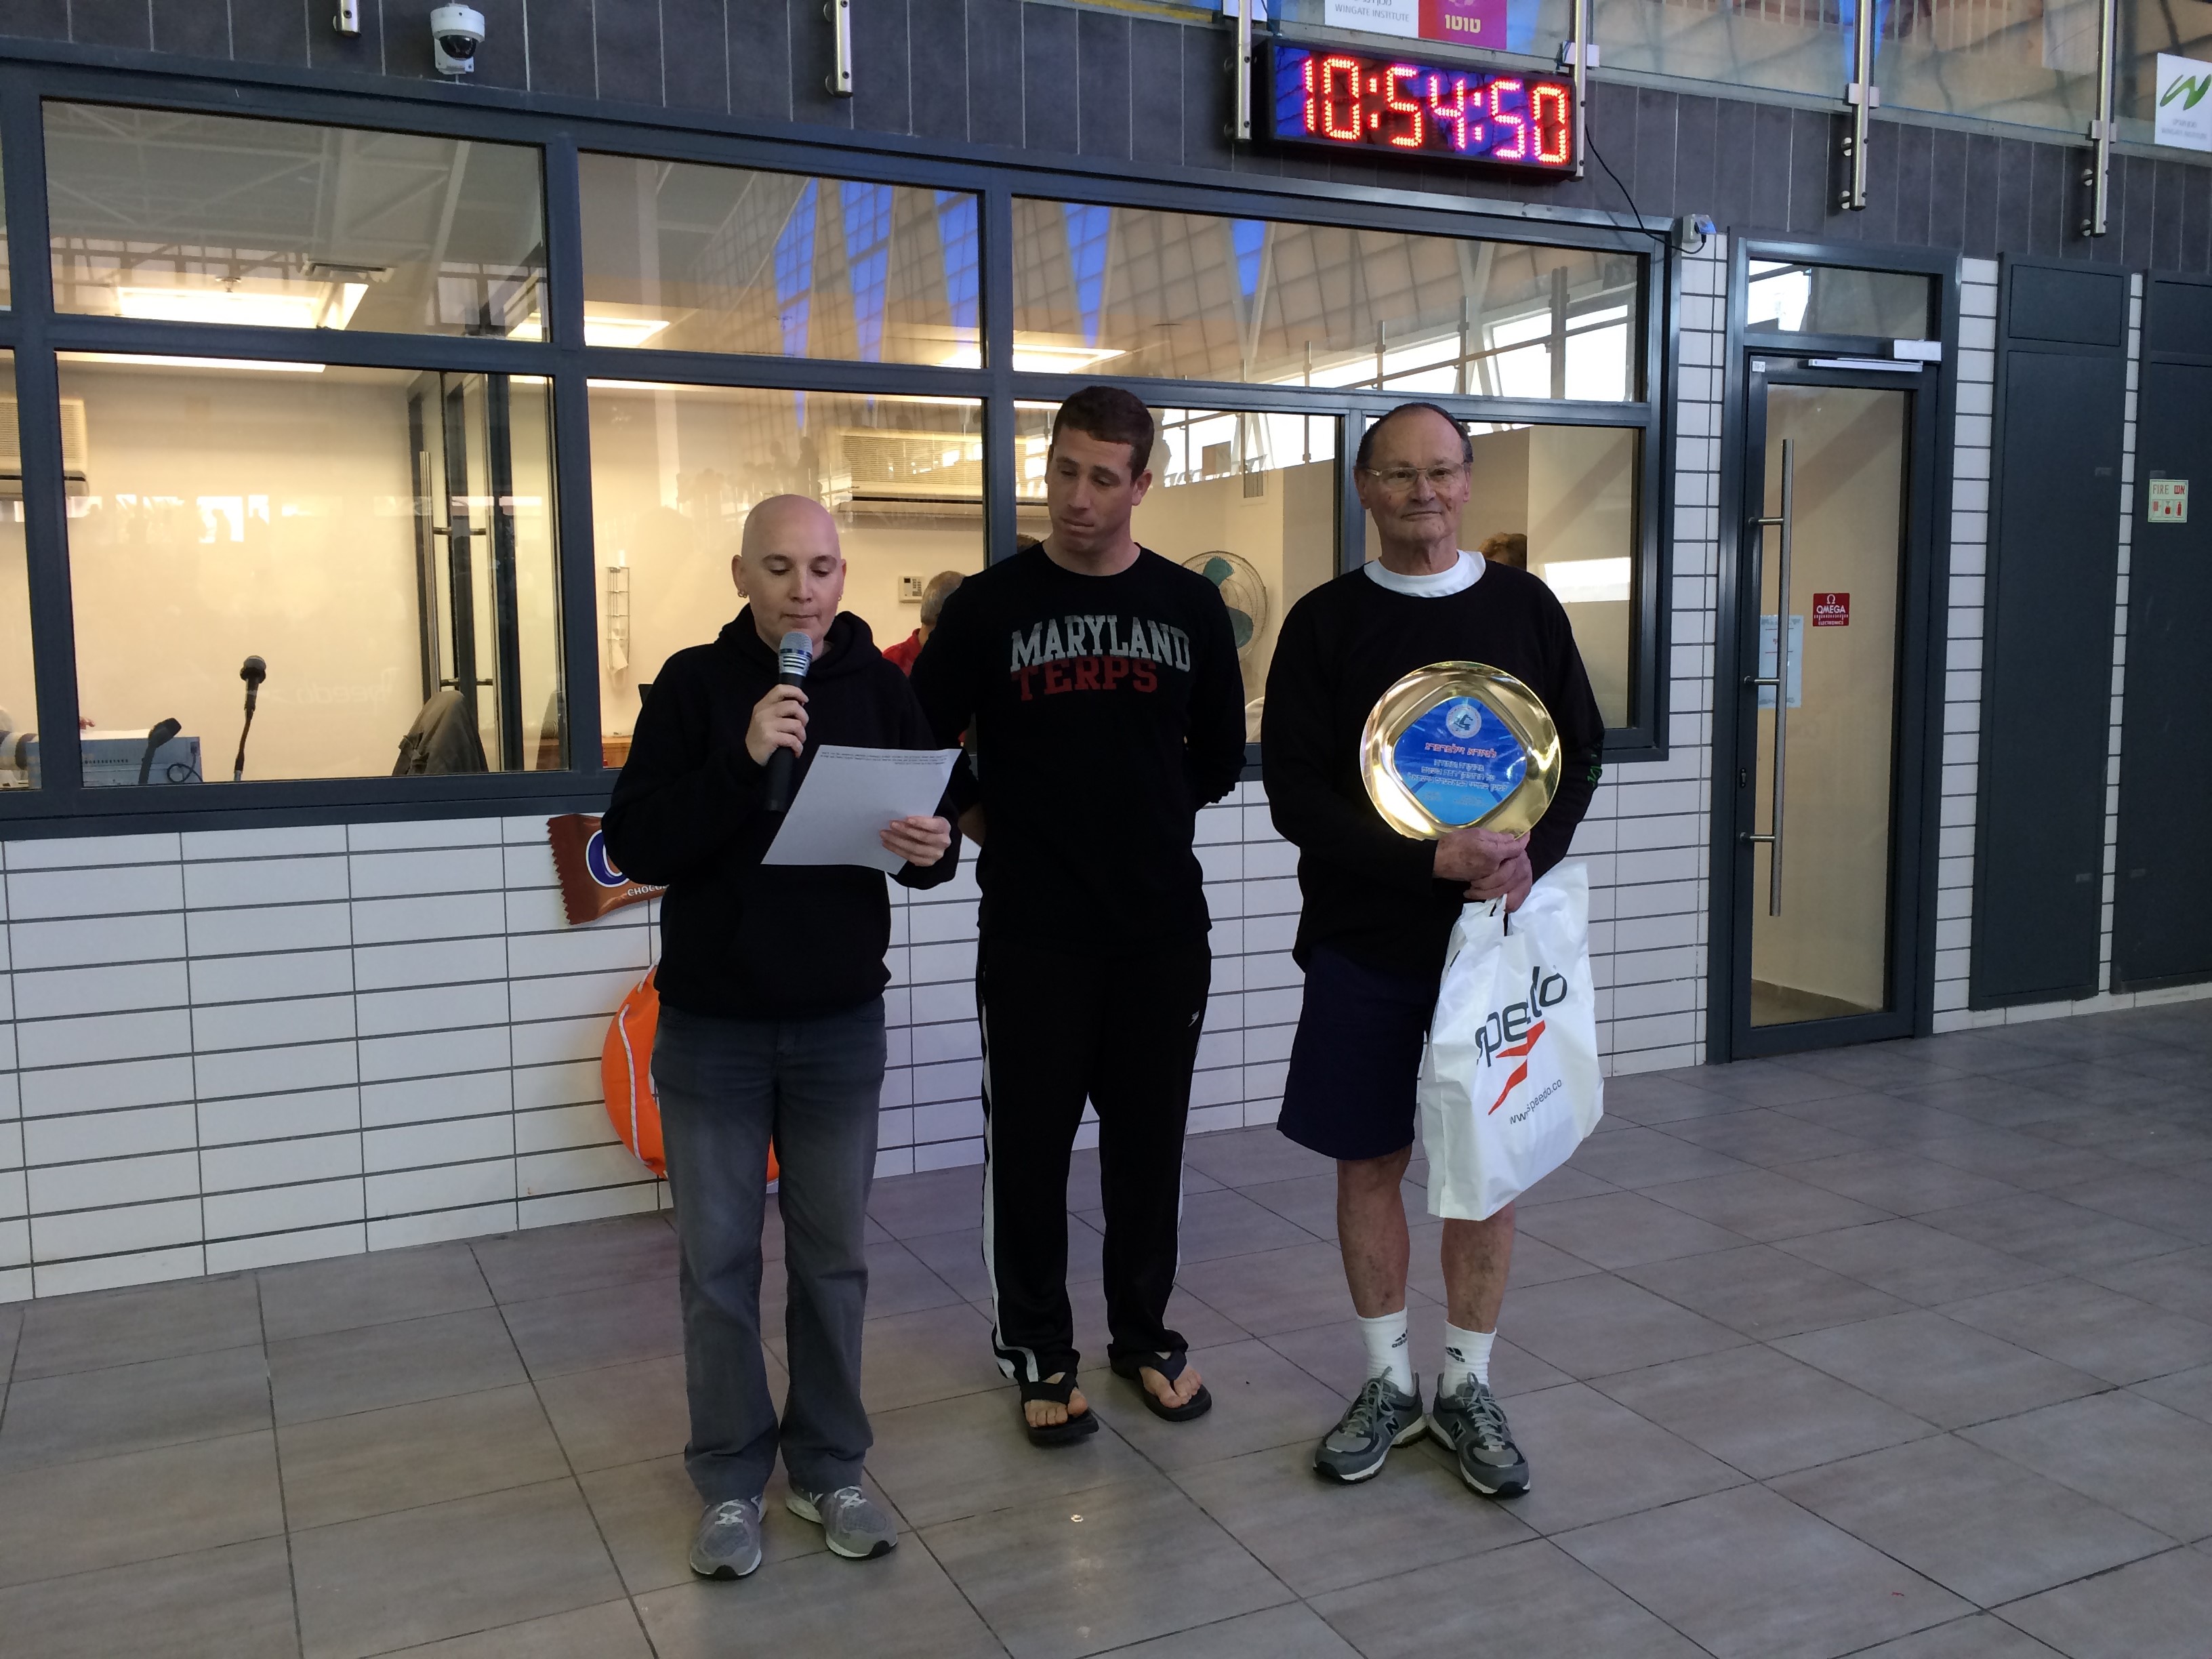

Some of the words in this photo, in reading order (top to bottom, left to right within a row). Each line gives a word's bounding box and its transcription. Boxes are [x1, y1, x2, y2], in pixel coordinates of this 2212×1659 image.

[1335, 3, 1370, 16] WINGATE
[1372, 9, 1410, 22] INSTITUTE
[1445, 14, 1481, 33] טוטו
[1303, 57, 1567, 164] 10:54:50
[2152, 484, 2169, 495] FIRE
[2173, 485, 2186, 495] אש
[1010, 614, 1191, 672] MARYLAND
[1011, 655, 1158, 701] TERPS
